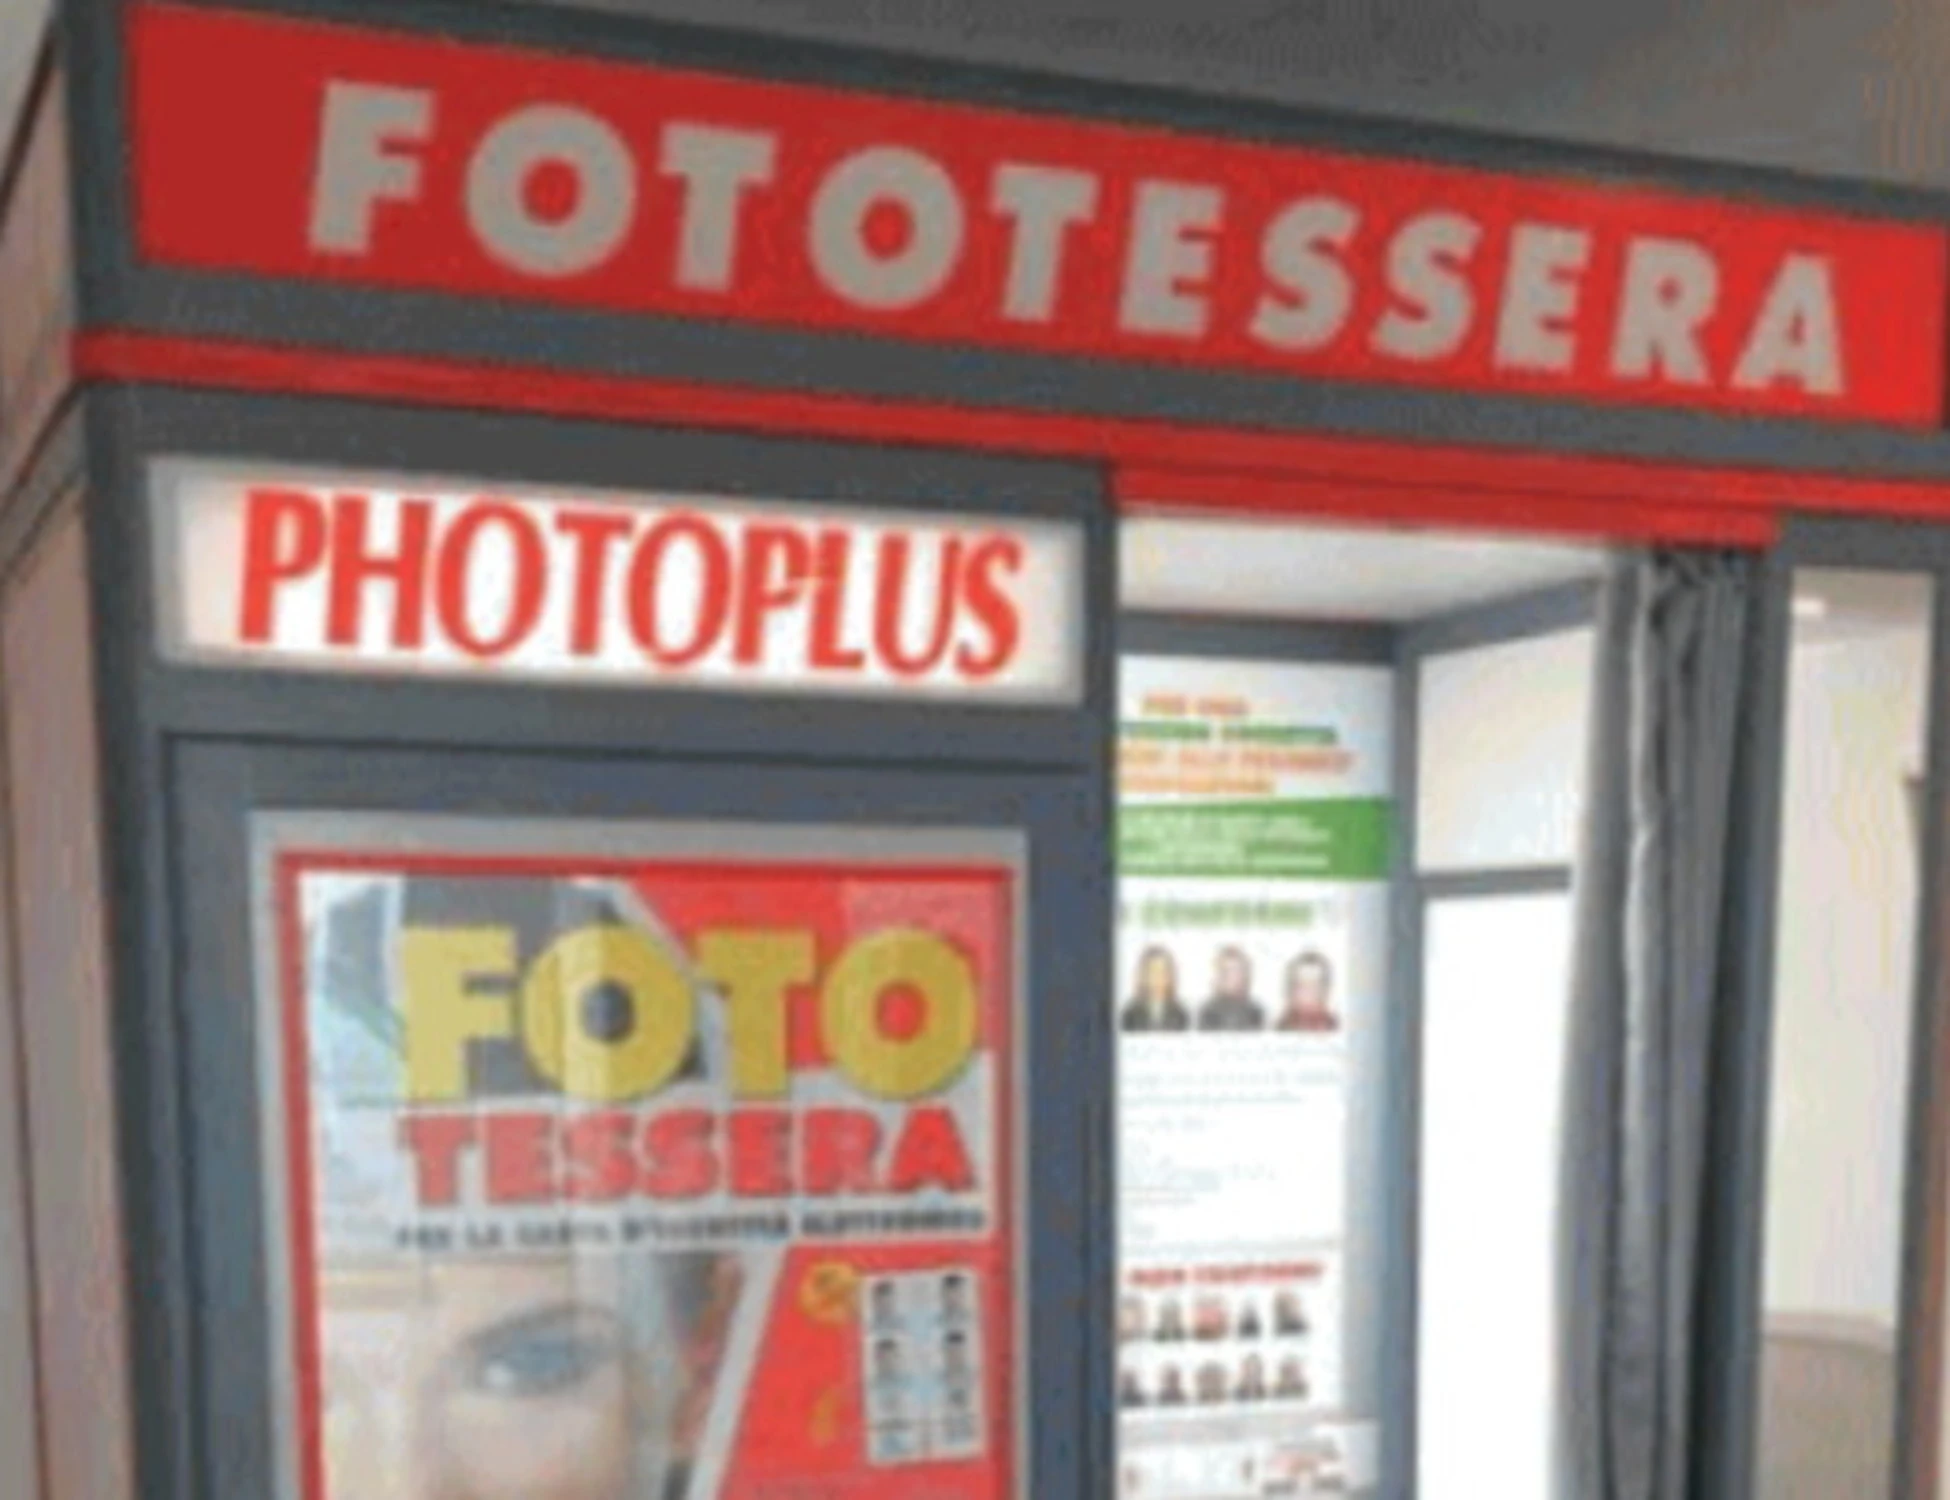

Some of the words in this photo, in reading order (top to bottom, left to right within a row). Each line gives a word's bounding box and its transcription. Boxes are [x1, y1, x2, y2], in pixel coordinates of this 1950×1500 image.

[308, 79, 1846, 397] FOTOTESSERA
[239, 487, 1024, 679] PHOTOPLUS
[398, 924, 977, 1101] FOTO
[398, 1107, 977, 1206] TESSERA
